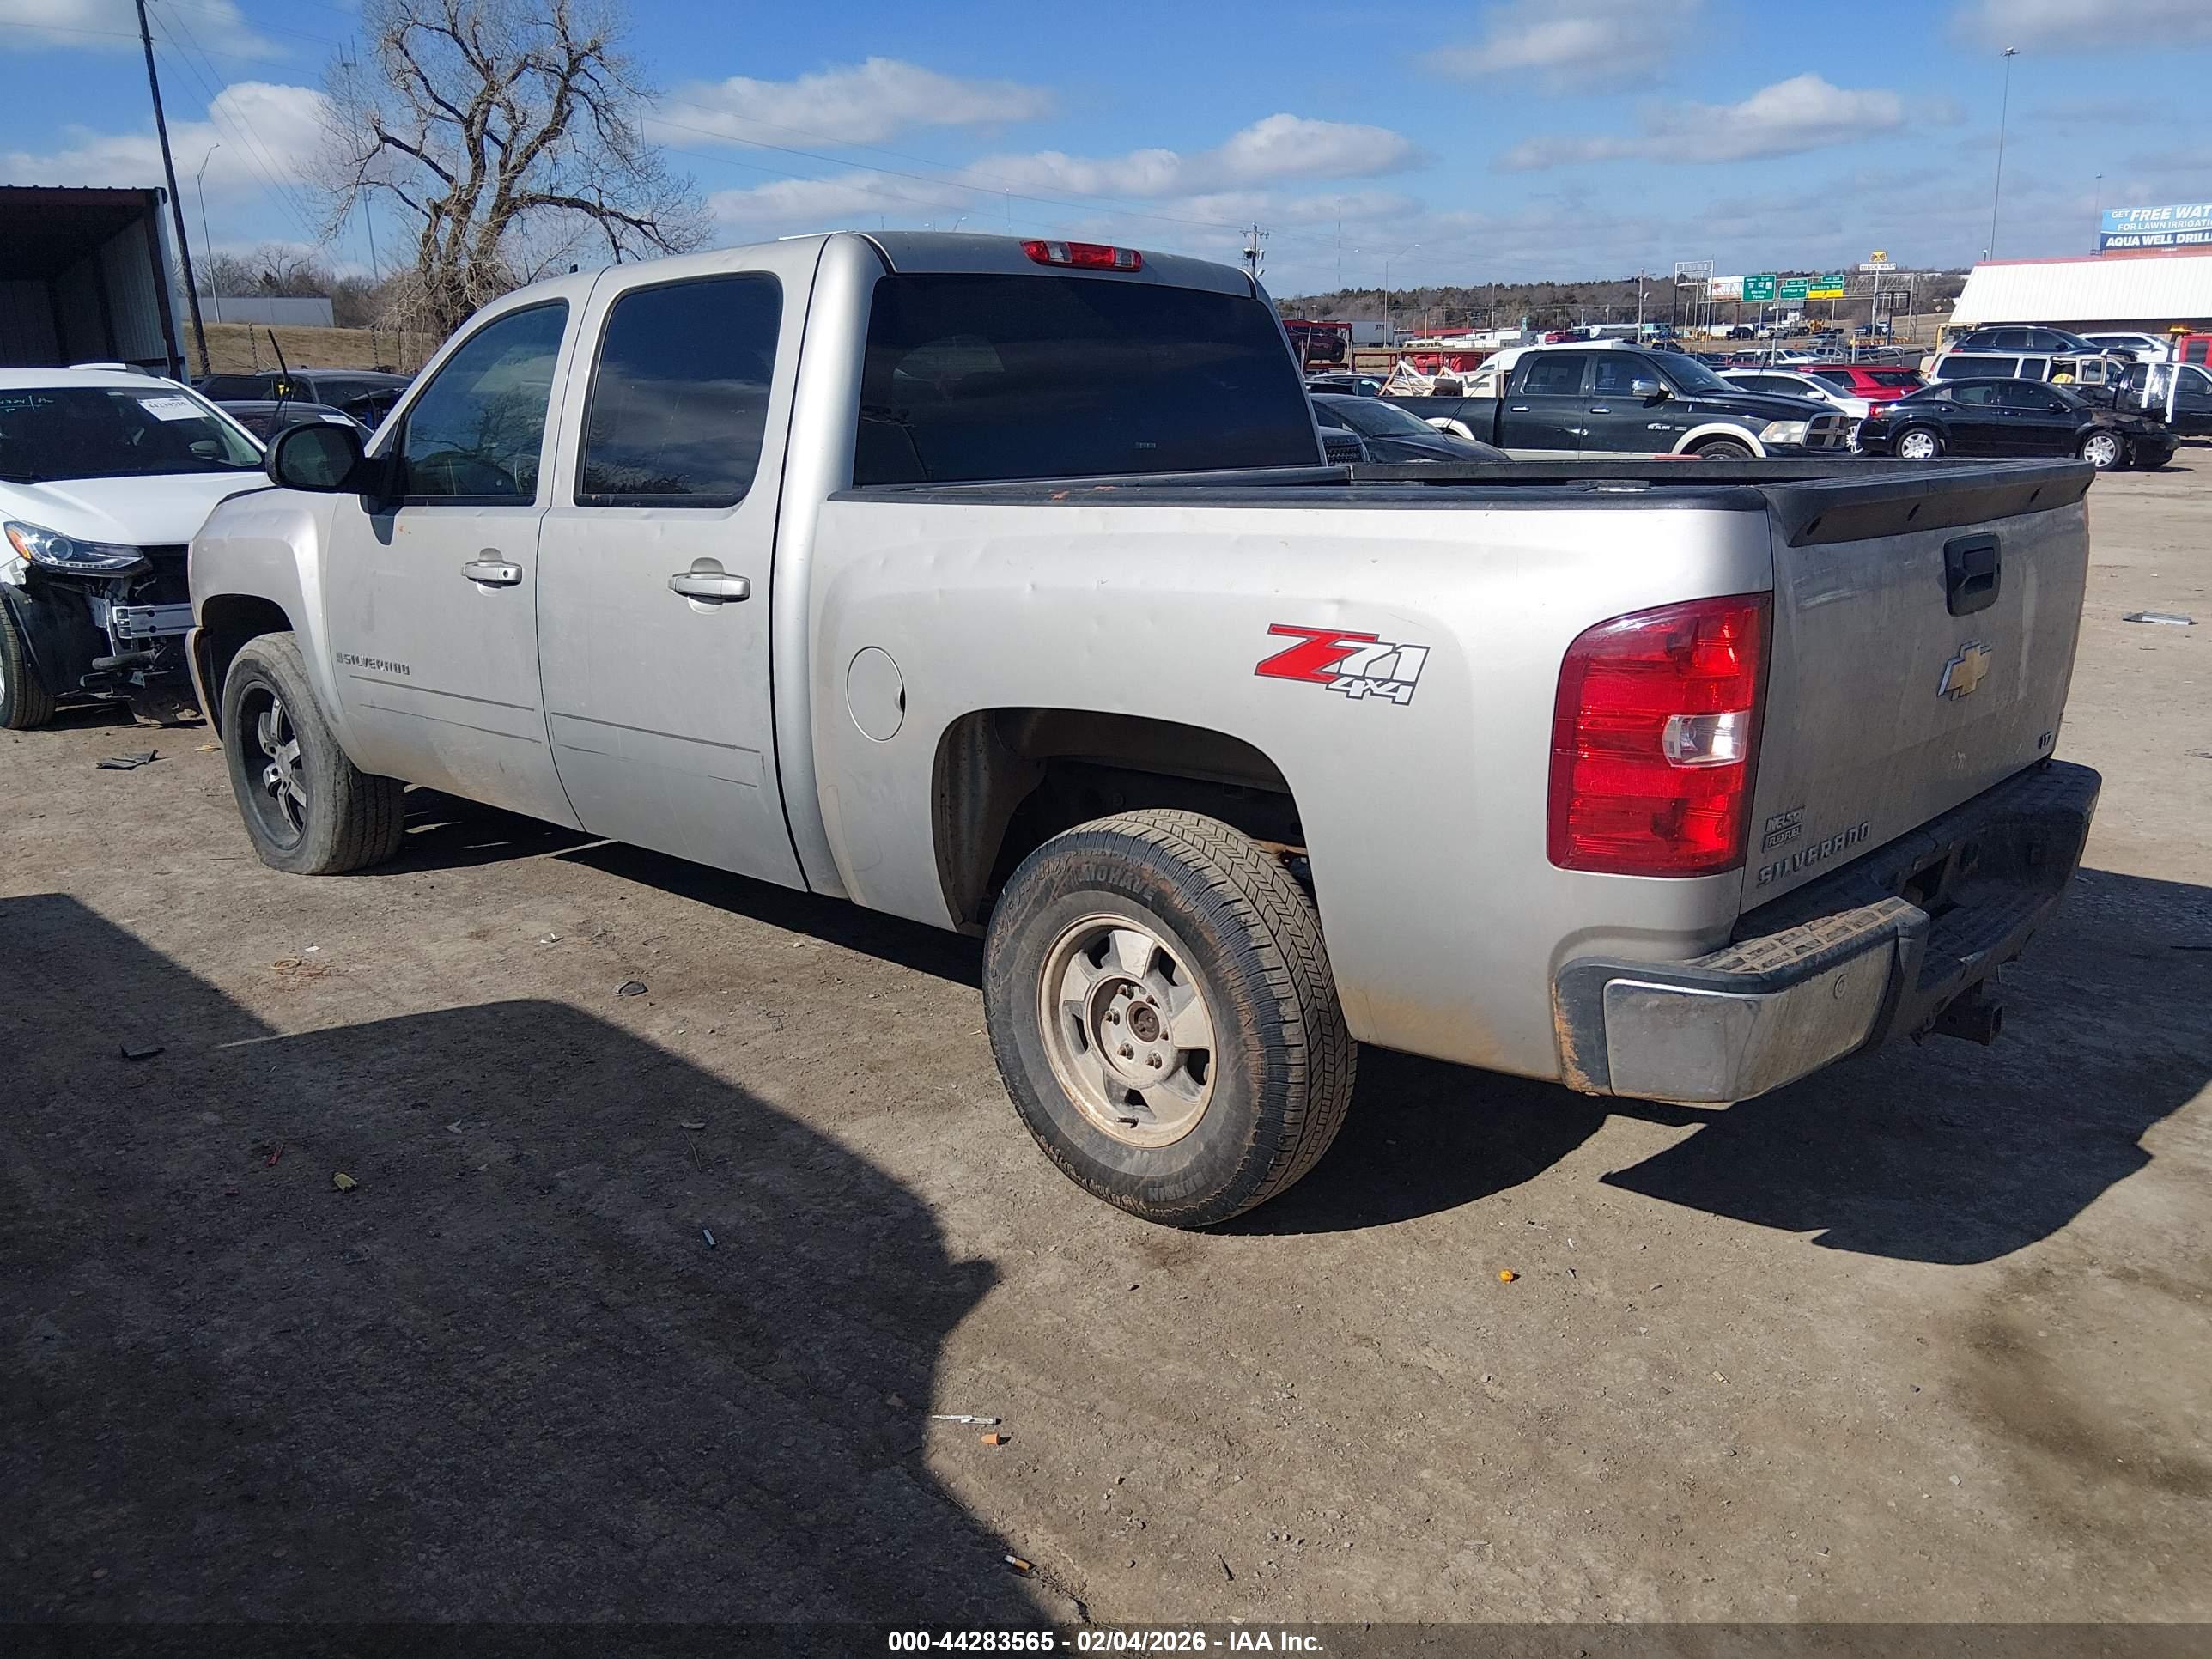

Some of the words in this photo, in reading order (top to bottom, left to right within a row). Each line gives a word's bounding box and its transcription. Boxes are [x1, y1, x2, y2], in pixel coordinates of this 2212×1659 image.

[2112, 210, 2130, 219] GET
[2130, 208, 2172, 222] FREE
[2118, 222, 2136, 231] FOR
[2138, 221, 2166, 230] LAWN
[2106, 236, 2140, 247] AQUA
[2142, 234, 2174, 246] WELL
[1254, 623, 1431, 686] Z71
[343, 653, 411, 676] SILVERADO
[1756, 821, 1871, 888] SILVERADO
